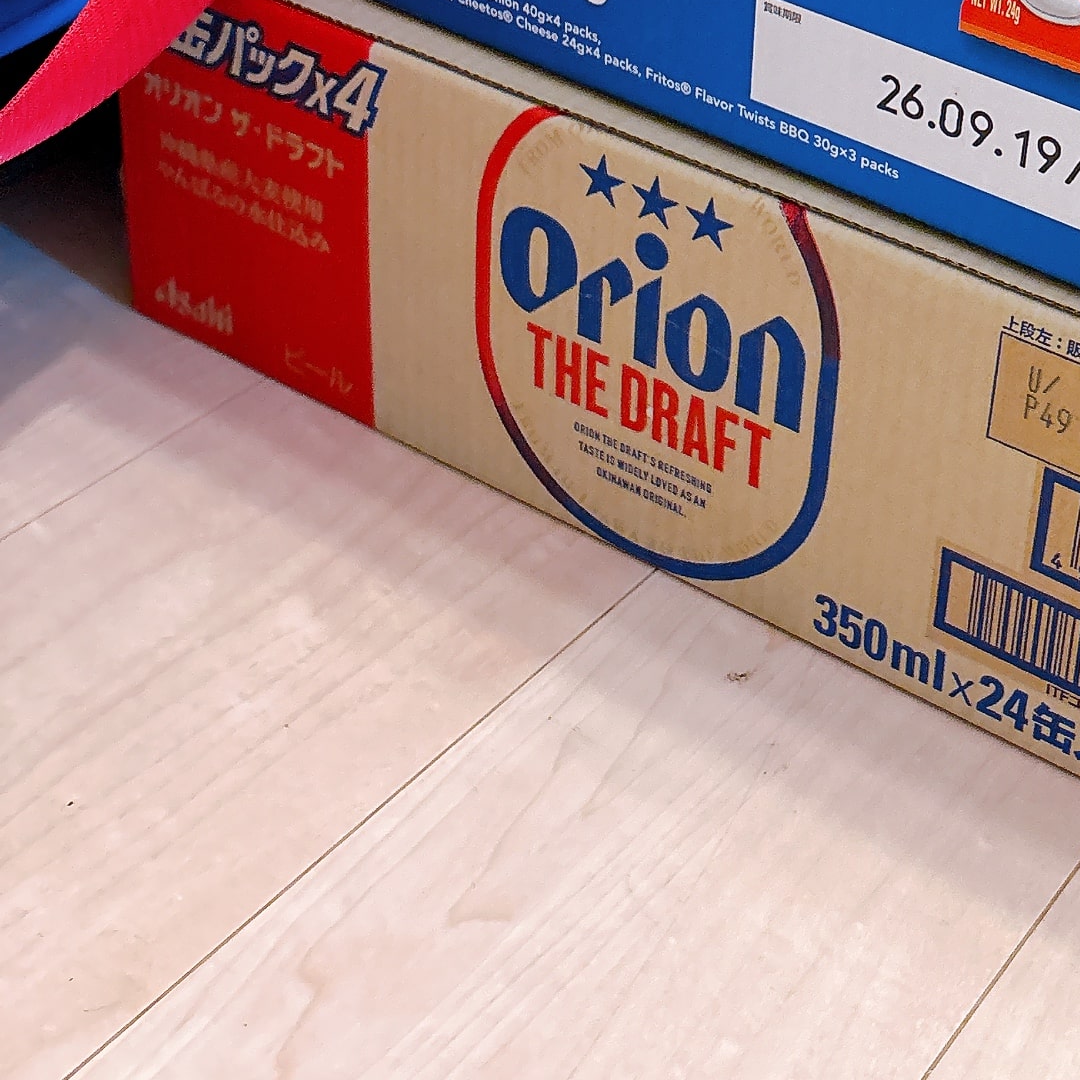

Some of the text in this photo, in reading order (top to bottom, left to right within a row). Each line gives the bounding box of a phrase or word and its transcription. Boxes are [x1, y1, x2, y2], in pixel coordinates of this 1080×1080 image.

[564, 20, 602, 46] packs,
[516, 15, 559, 43] Cheese
[604, 52, 642, 78] packs,
[694, 86, 734, 113] Flavor
[737, 103, 776, 130] Twists
[779, 120, 810, 144] BBQ
[860, 155, 900, 180] packs
[283, 342, 353, 395] ビール
[526, 321, 610, 419] THE
[620, 363, 773, 489] DRAFT
[1022, 394, 1073, 434] P49
[573, 421, 601, 441] ORION
[602, 433, 618, 449] THE
[657, 460, 712, 494] REFRESHING
[578, 440, 706, 509] TASTE IS WIDELY LOVED AS AN
[596, 466, 687, 518] OKINAWAN ORIGINAL.
[1050, 552, 1062, 570] 4
